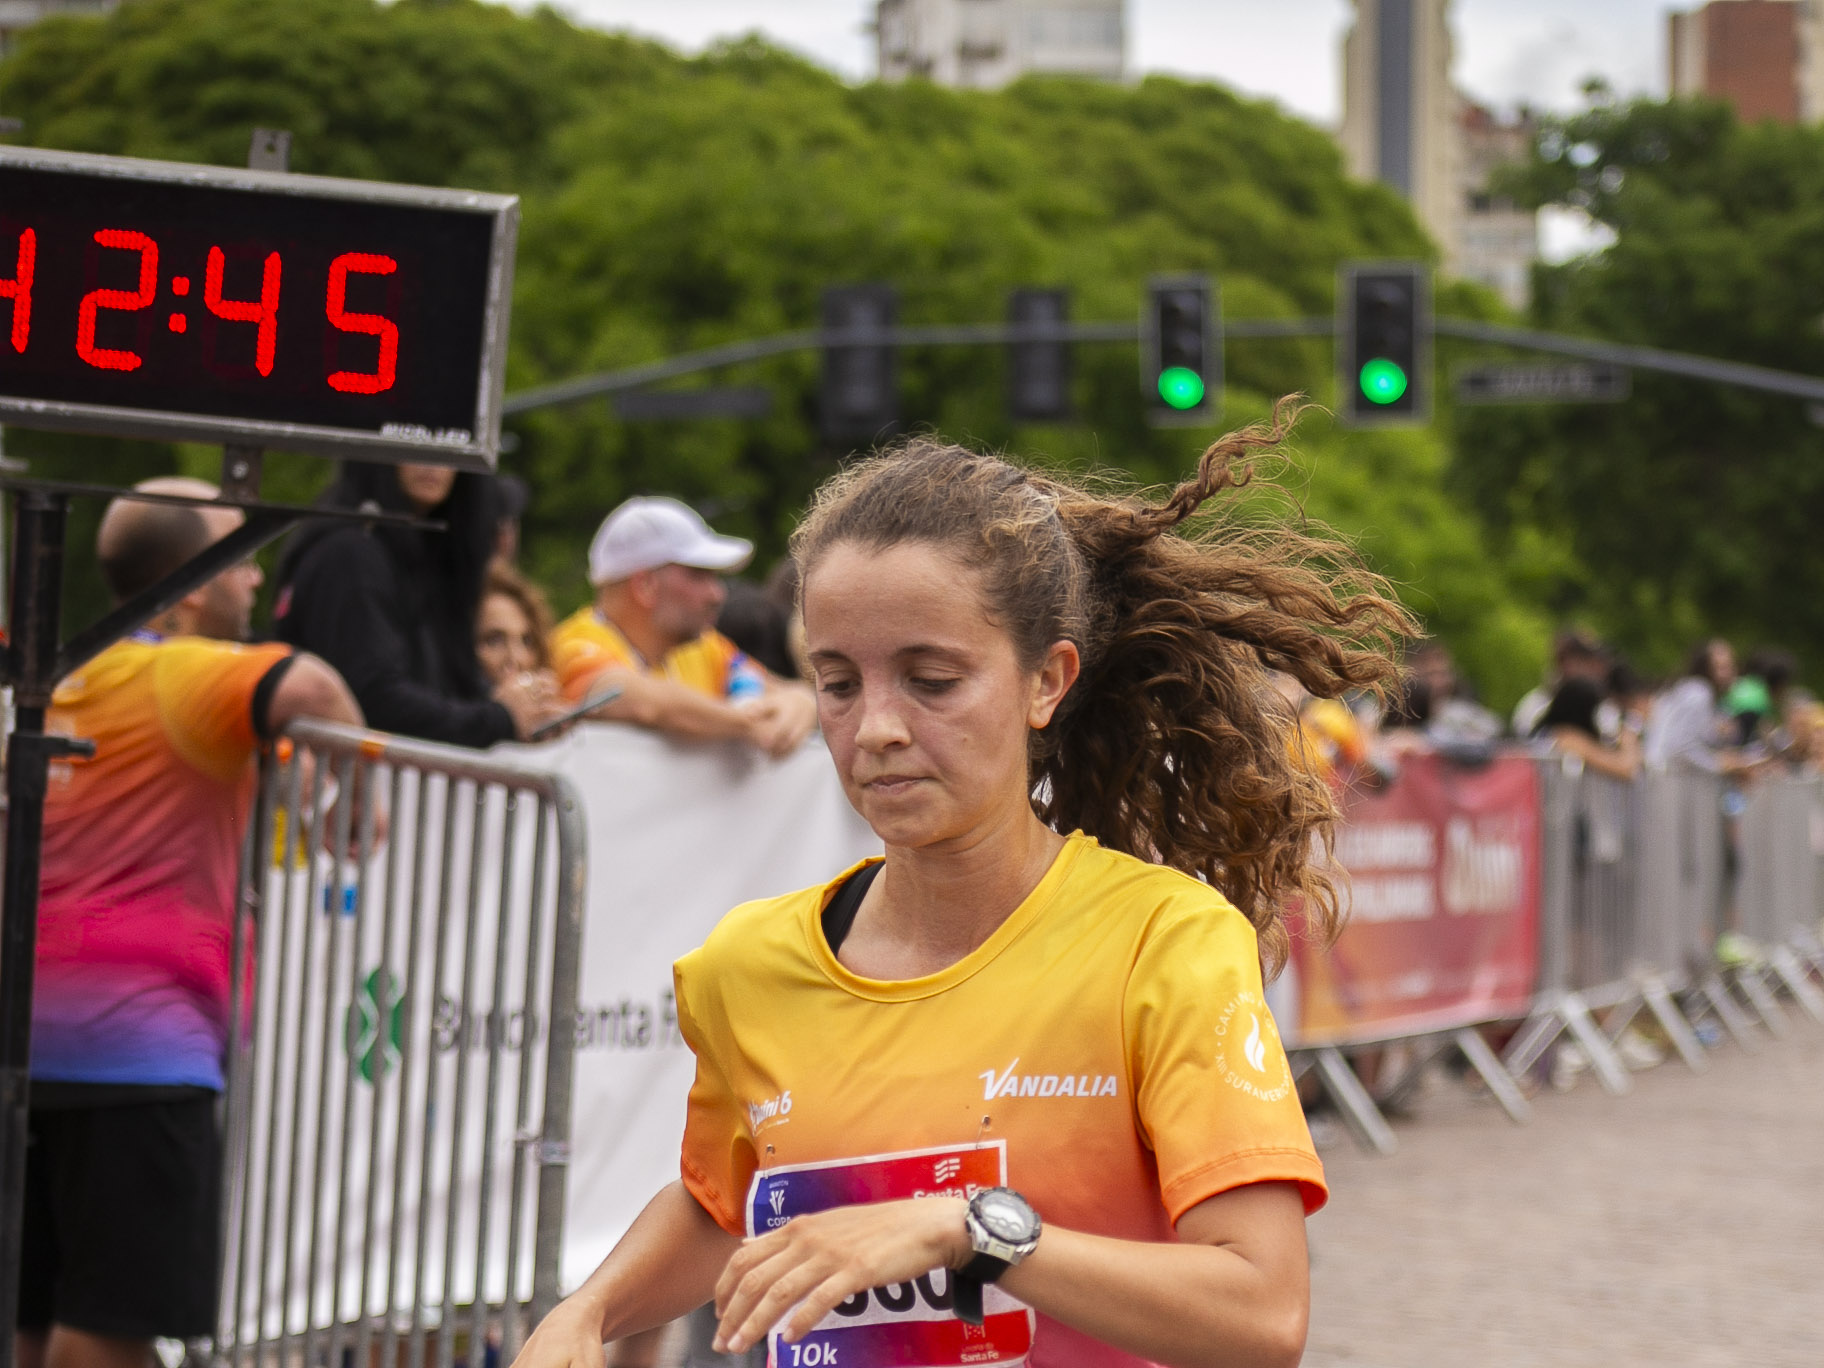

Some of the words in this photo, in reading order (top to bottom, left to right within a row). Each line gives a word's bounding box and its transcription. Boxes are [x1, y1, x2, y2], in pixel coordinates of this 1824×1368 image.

[564, 998, 653, 1049] anta
[1214, 991, 1256, 1036] CAMINO
[978, 1057, 1117, 1100] VANDALIA
[790, 1342, 838, 1367] 10k
[961, 1352, 987, 1363] Santa
